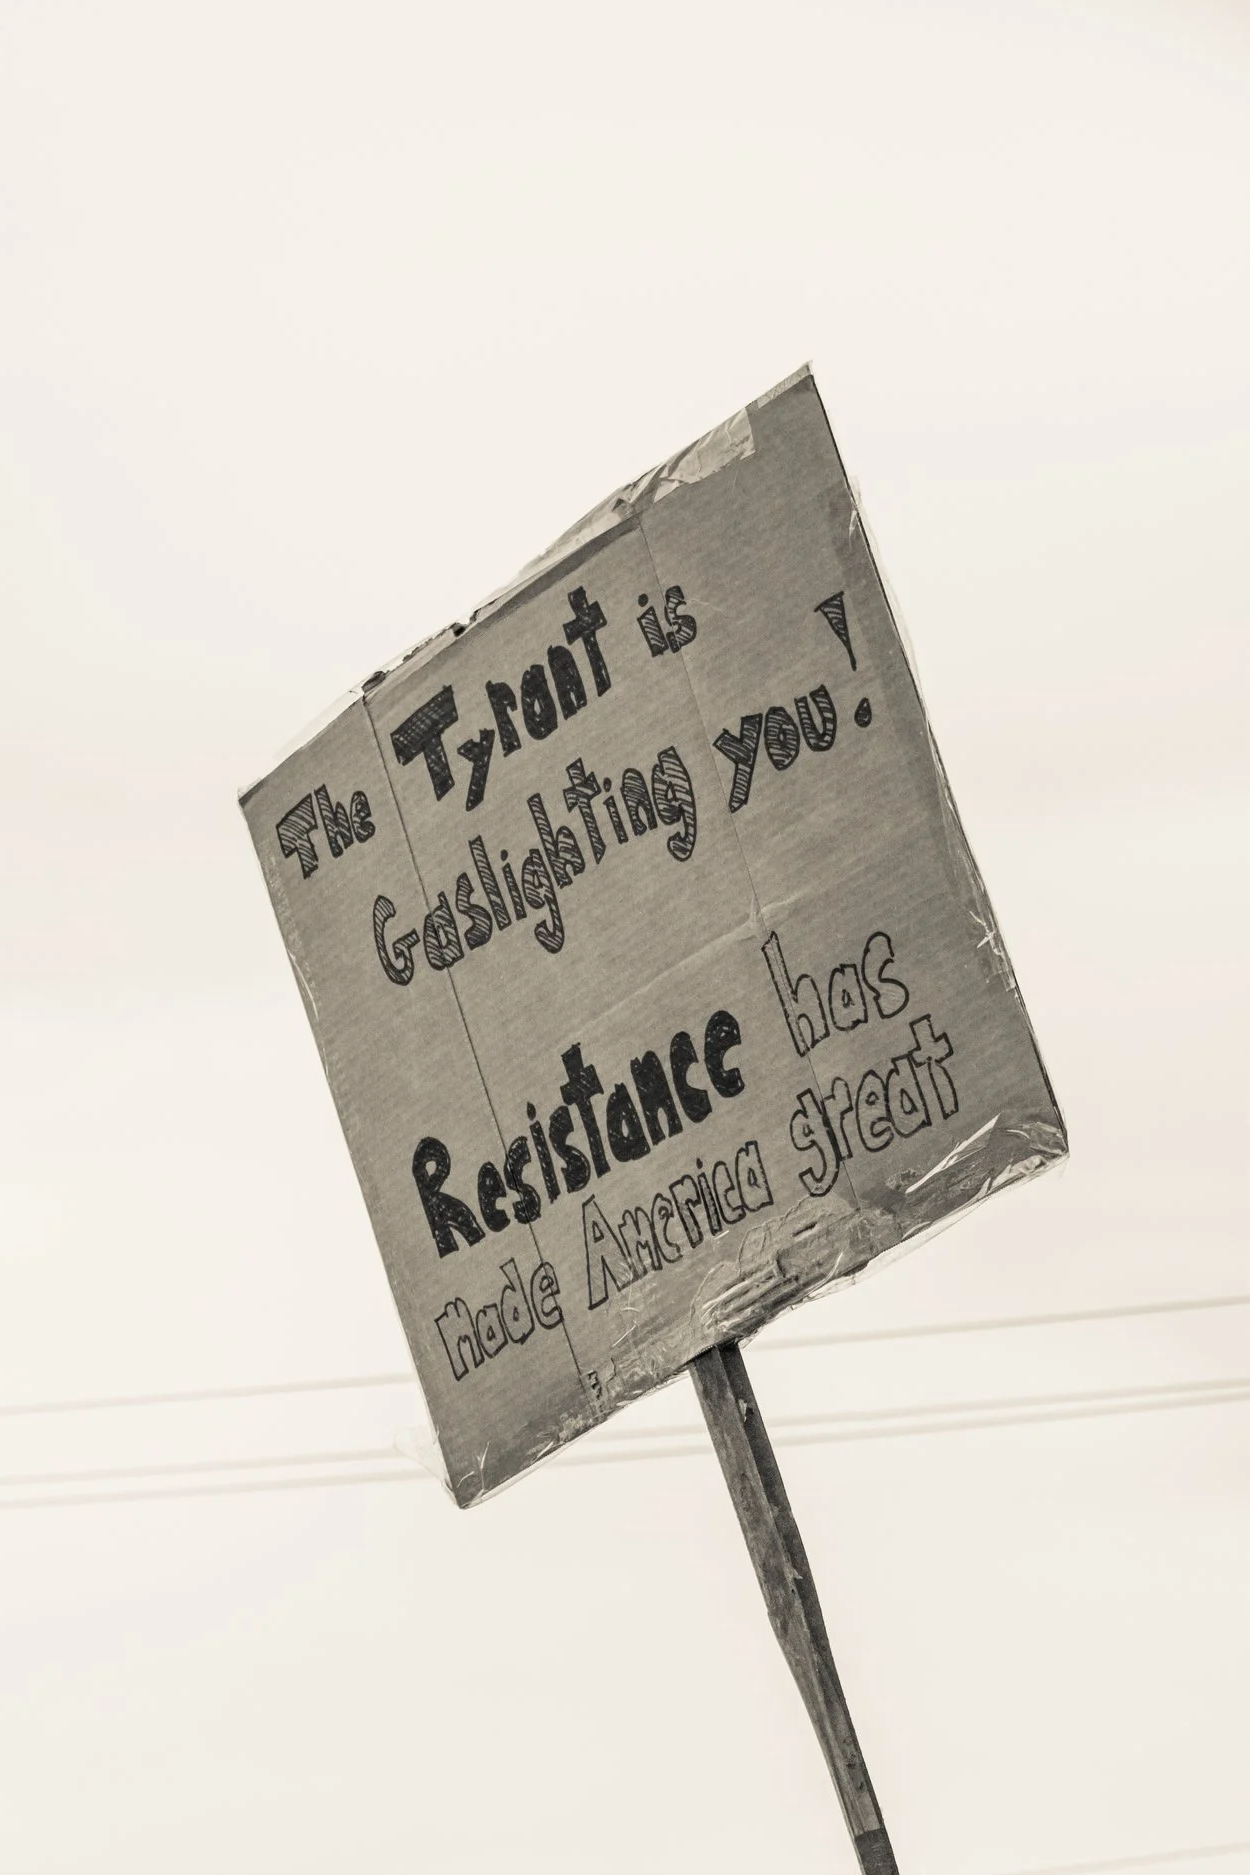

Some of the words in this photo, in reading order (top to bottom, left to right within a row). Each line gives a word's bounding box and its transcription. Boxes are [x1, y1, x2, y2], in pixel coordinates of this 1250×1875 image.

[277, 784, 375, 879] The
[390, 585, 610, 811] Tyrant
[636, 585, 698, 658] is
[373, 746, 698, 986] Gaslighting
[712, 591, 873, 813] you!
[412, 1010, 745, 1258] Resistance
[761, 931, 911, 1057] has
[435, 1257, 564, 1381] Made
[581, 1140, 774, 1310] America
[790, 1014, 960, 1196] great
